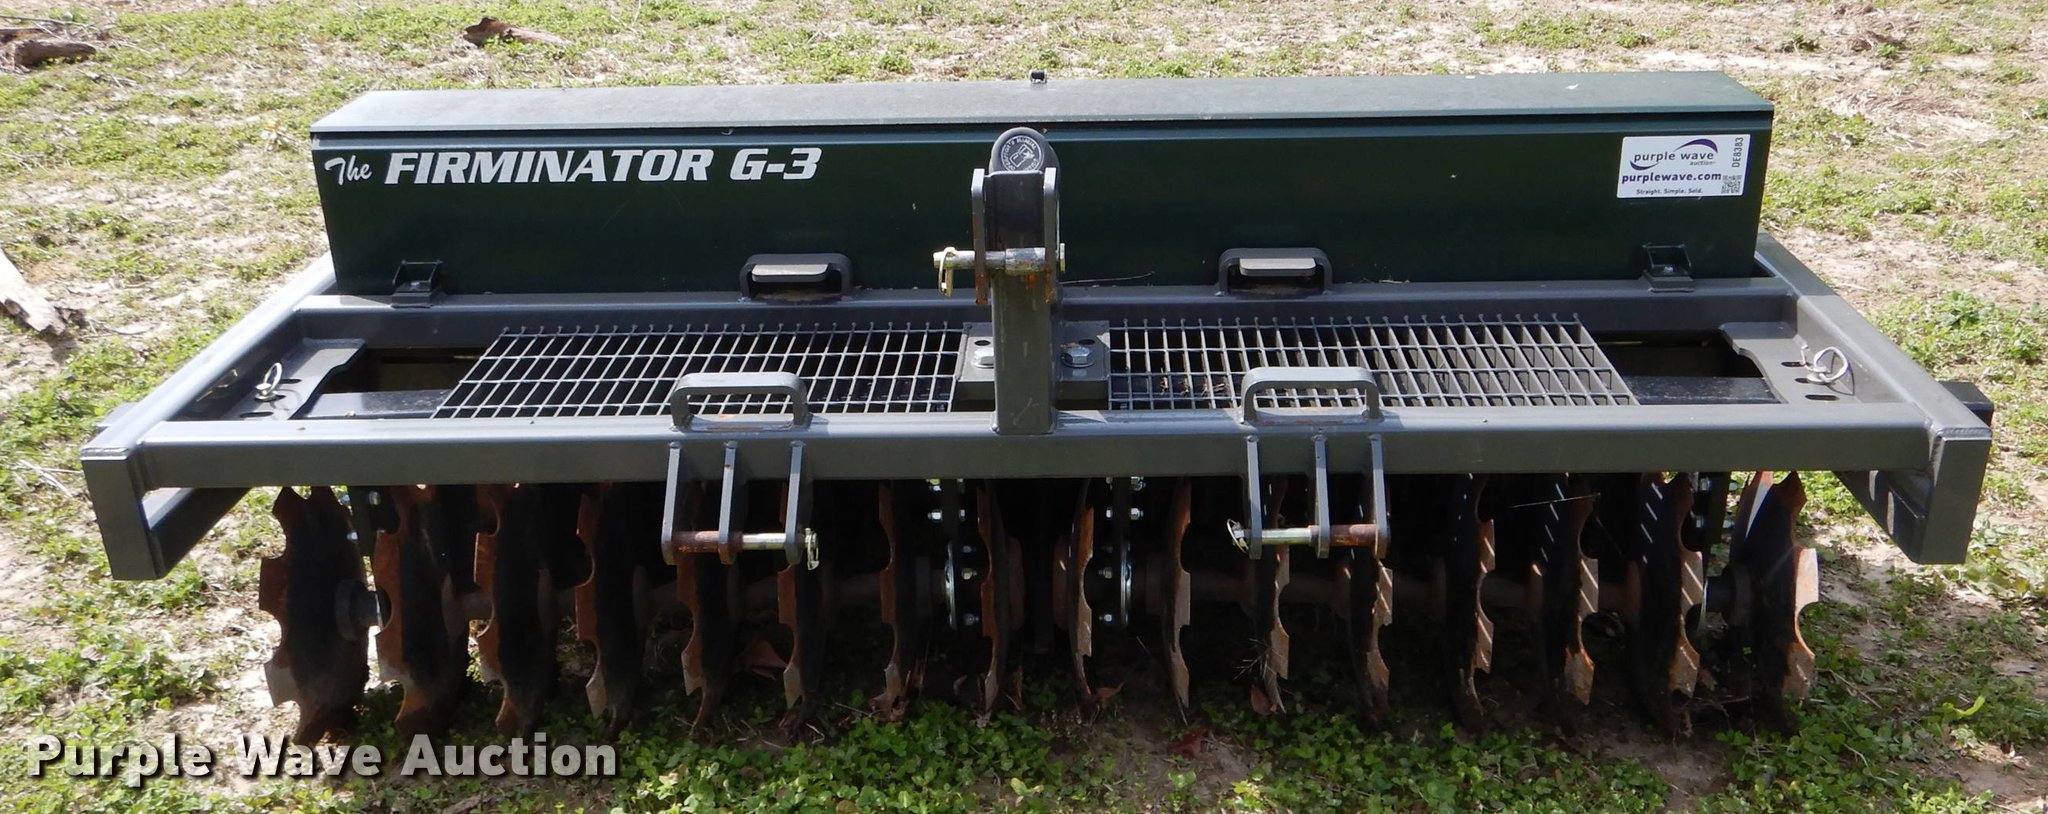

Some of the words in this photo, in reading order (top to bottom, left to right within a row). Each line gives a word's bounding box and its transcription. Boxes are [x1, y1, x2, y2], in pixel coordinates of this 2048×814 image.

[1633, 151, 1676, 163] purple
[1680, 152, 1714, 161] wave
[1731, 137, 1744, 168] DE8383
[324, 154, 373, 186] The
[384, 148, 714, 185] FIRMINATOR
[729, 147, 822, 182] G-3
[1621, 172, 1722, 184] purplewave.com
